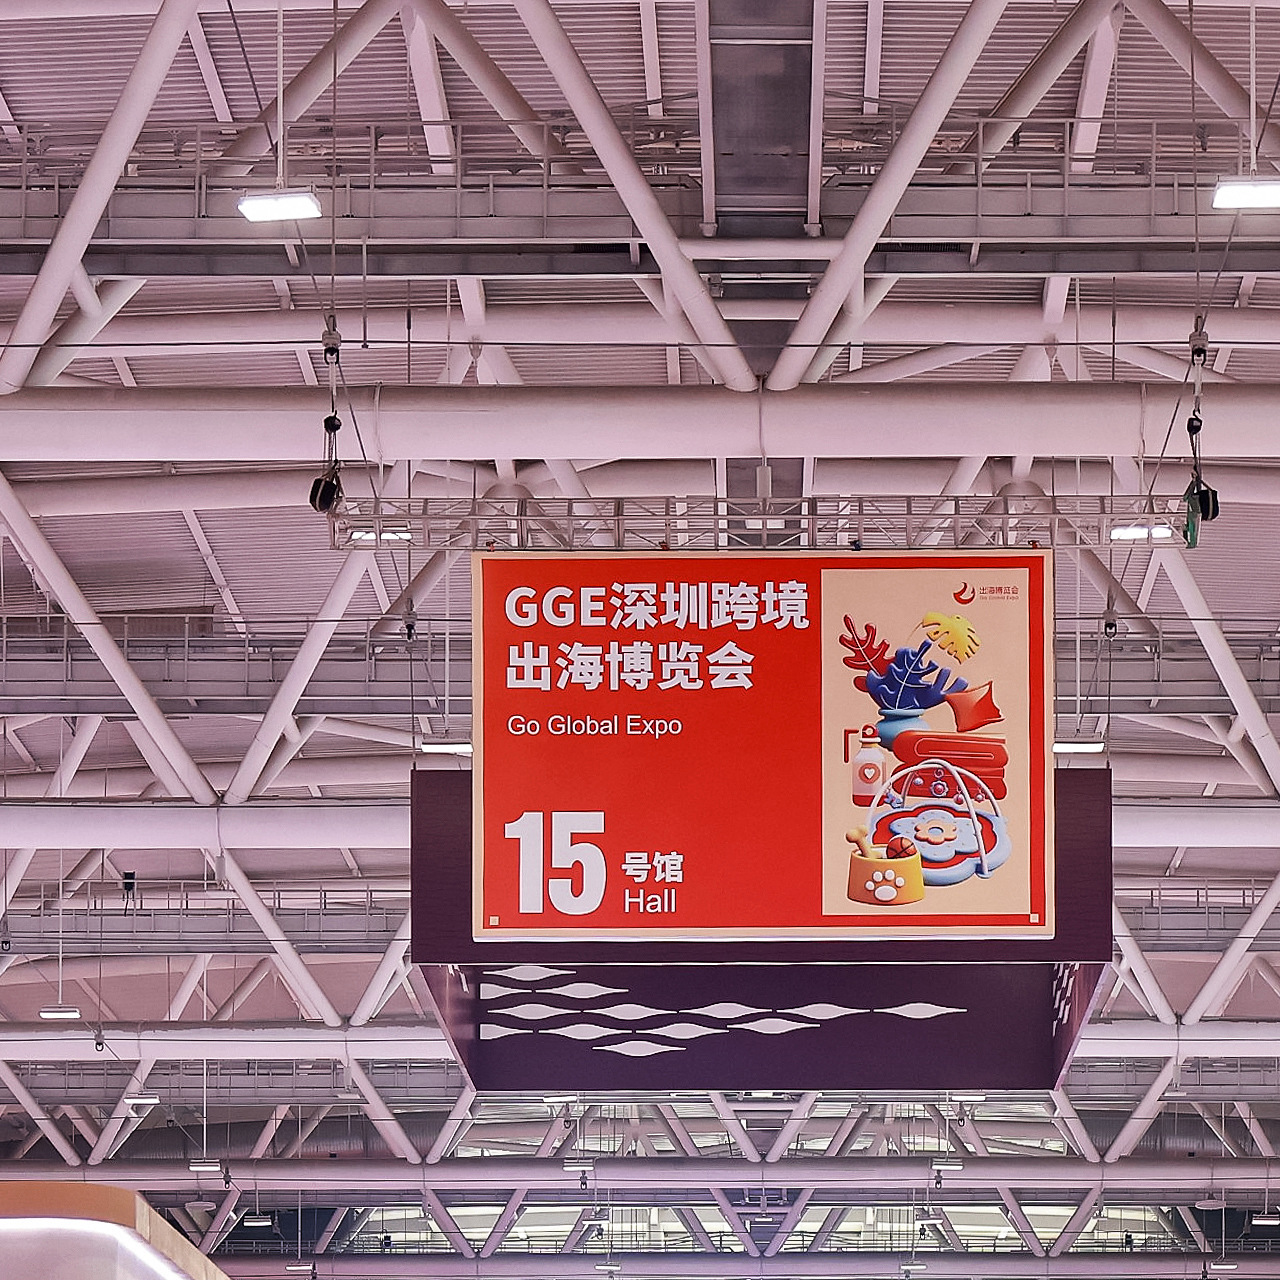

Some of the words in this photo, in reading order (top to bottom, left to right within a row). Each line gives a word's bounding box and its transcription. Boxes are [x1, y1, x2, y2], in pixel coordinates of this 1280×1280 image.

[505, 581, 809, 630] GGE深圳跨境
[505, 642, 755, 691] 出海博览会
[507, 715, 540, 735] Go
[547, 714, 618, 736] Global
[625, 715, 682, 740] Expo
[504, 810, 608, 916] 15
[621, 851, 685, 883] 号馆
[623, 887, 677, 914] Hall
